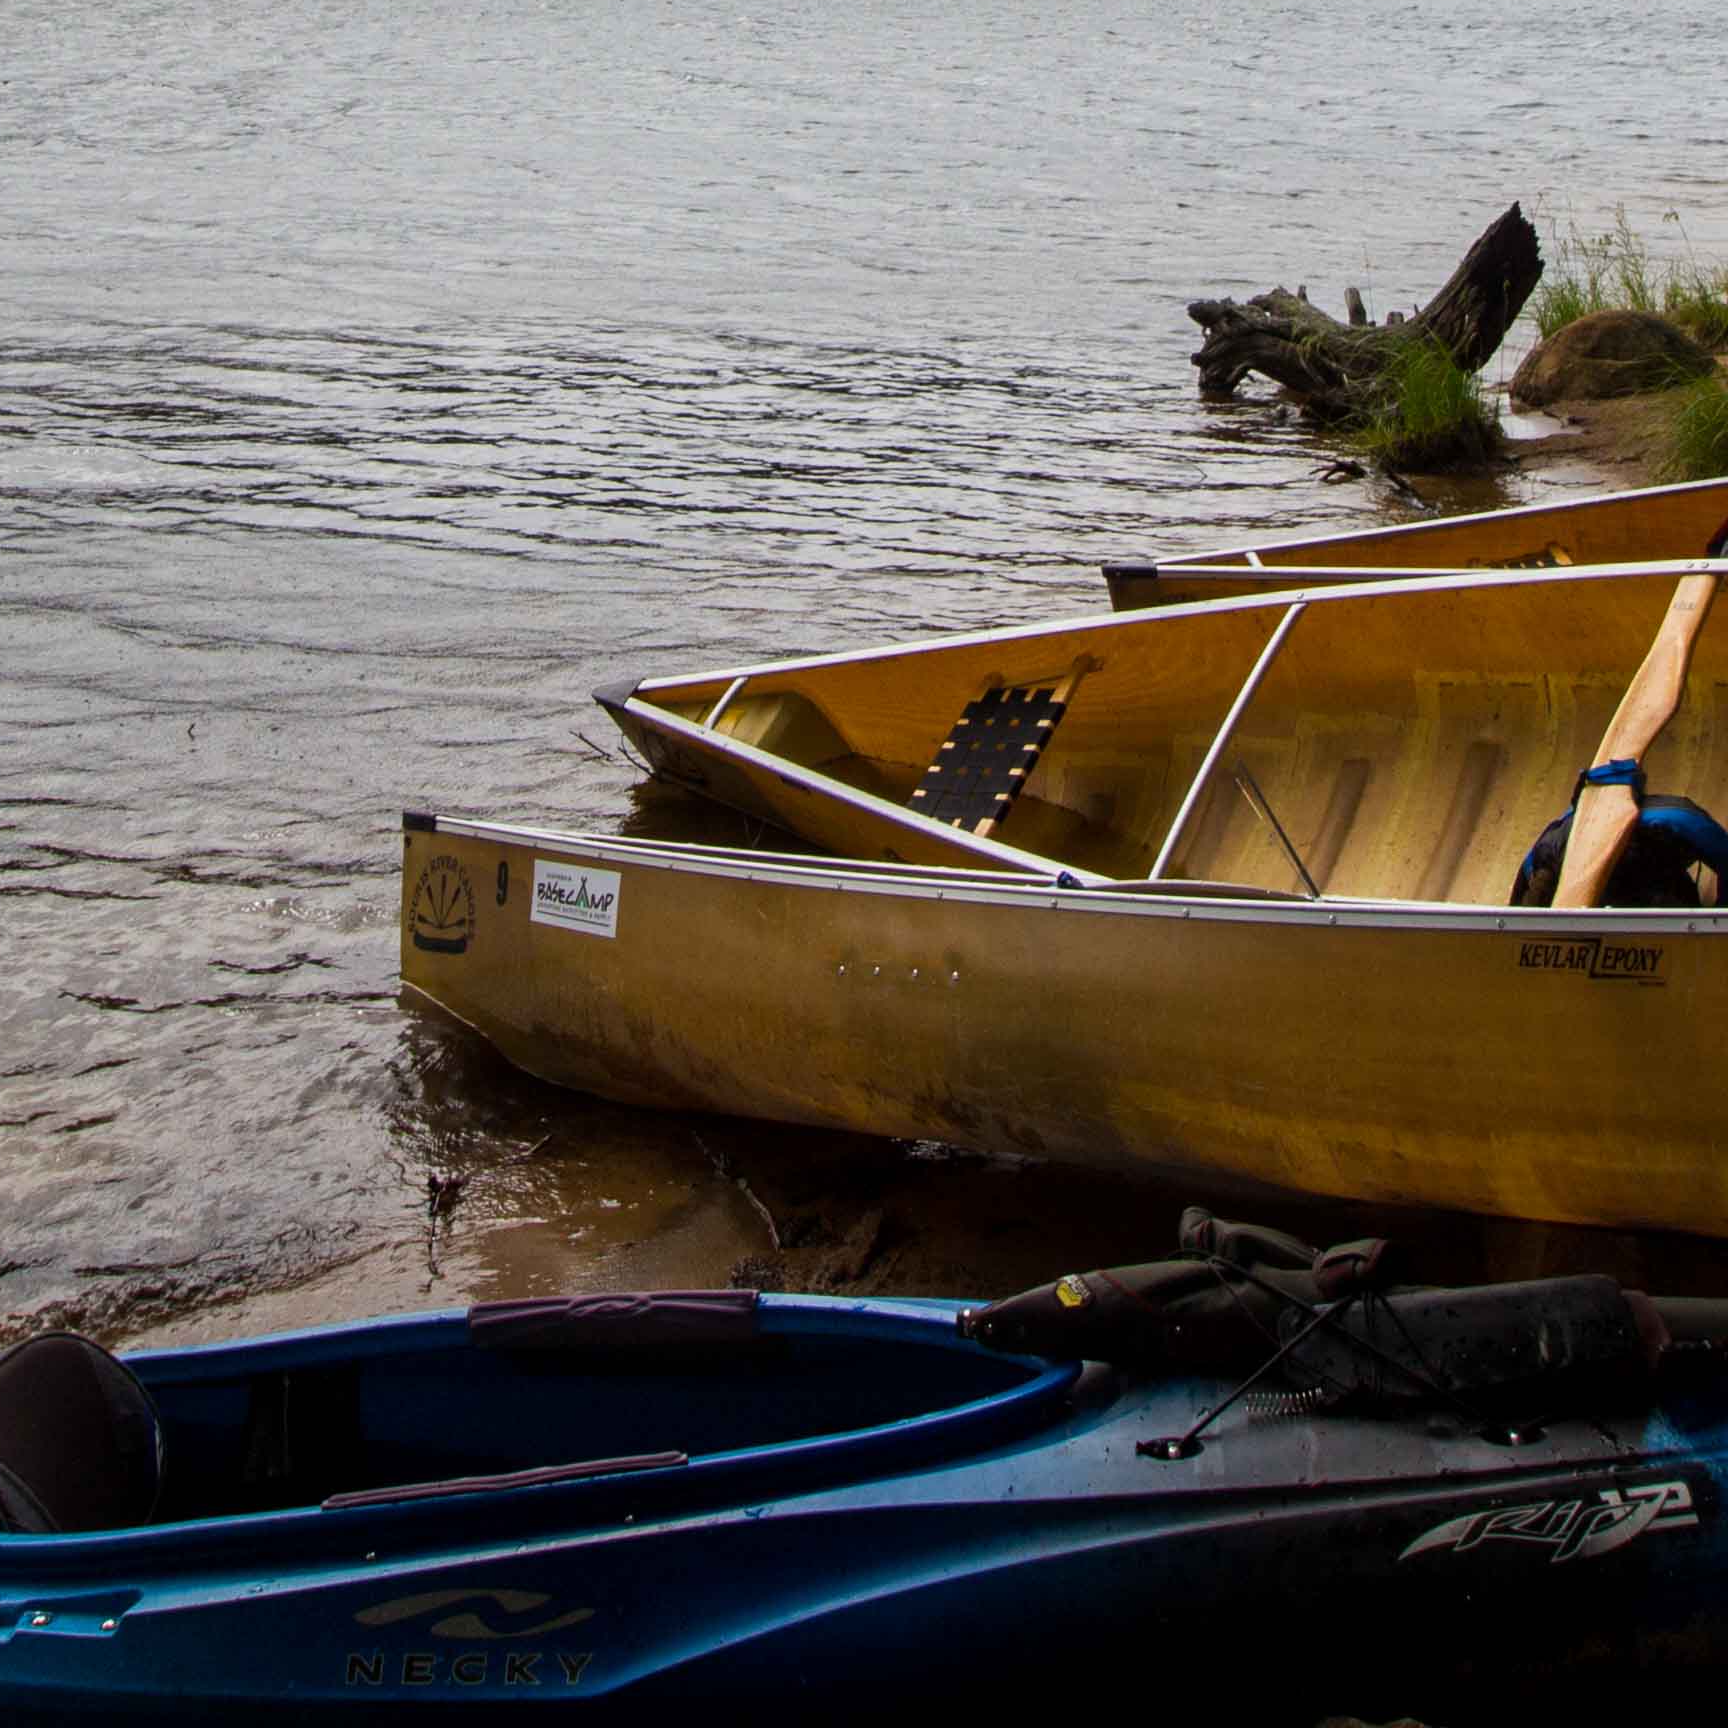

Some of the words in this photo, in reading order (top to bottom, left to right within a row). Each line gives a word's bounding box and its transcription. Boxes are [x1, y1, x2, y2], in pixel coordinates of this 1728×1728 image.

[496, 860, 509, 906] 9
[537, 877, 614, 912] BASECAMP
[1518, 943, 1590, 969] KEVLAR
[1601, 945, 1664, 972] EPOXY
[346, 1651, 593, 1685] NECKY
